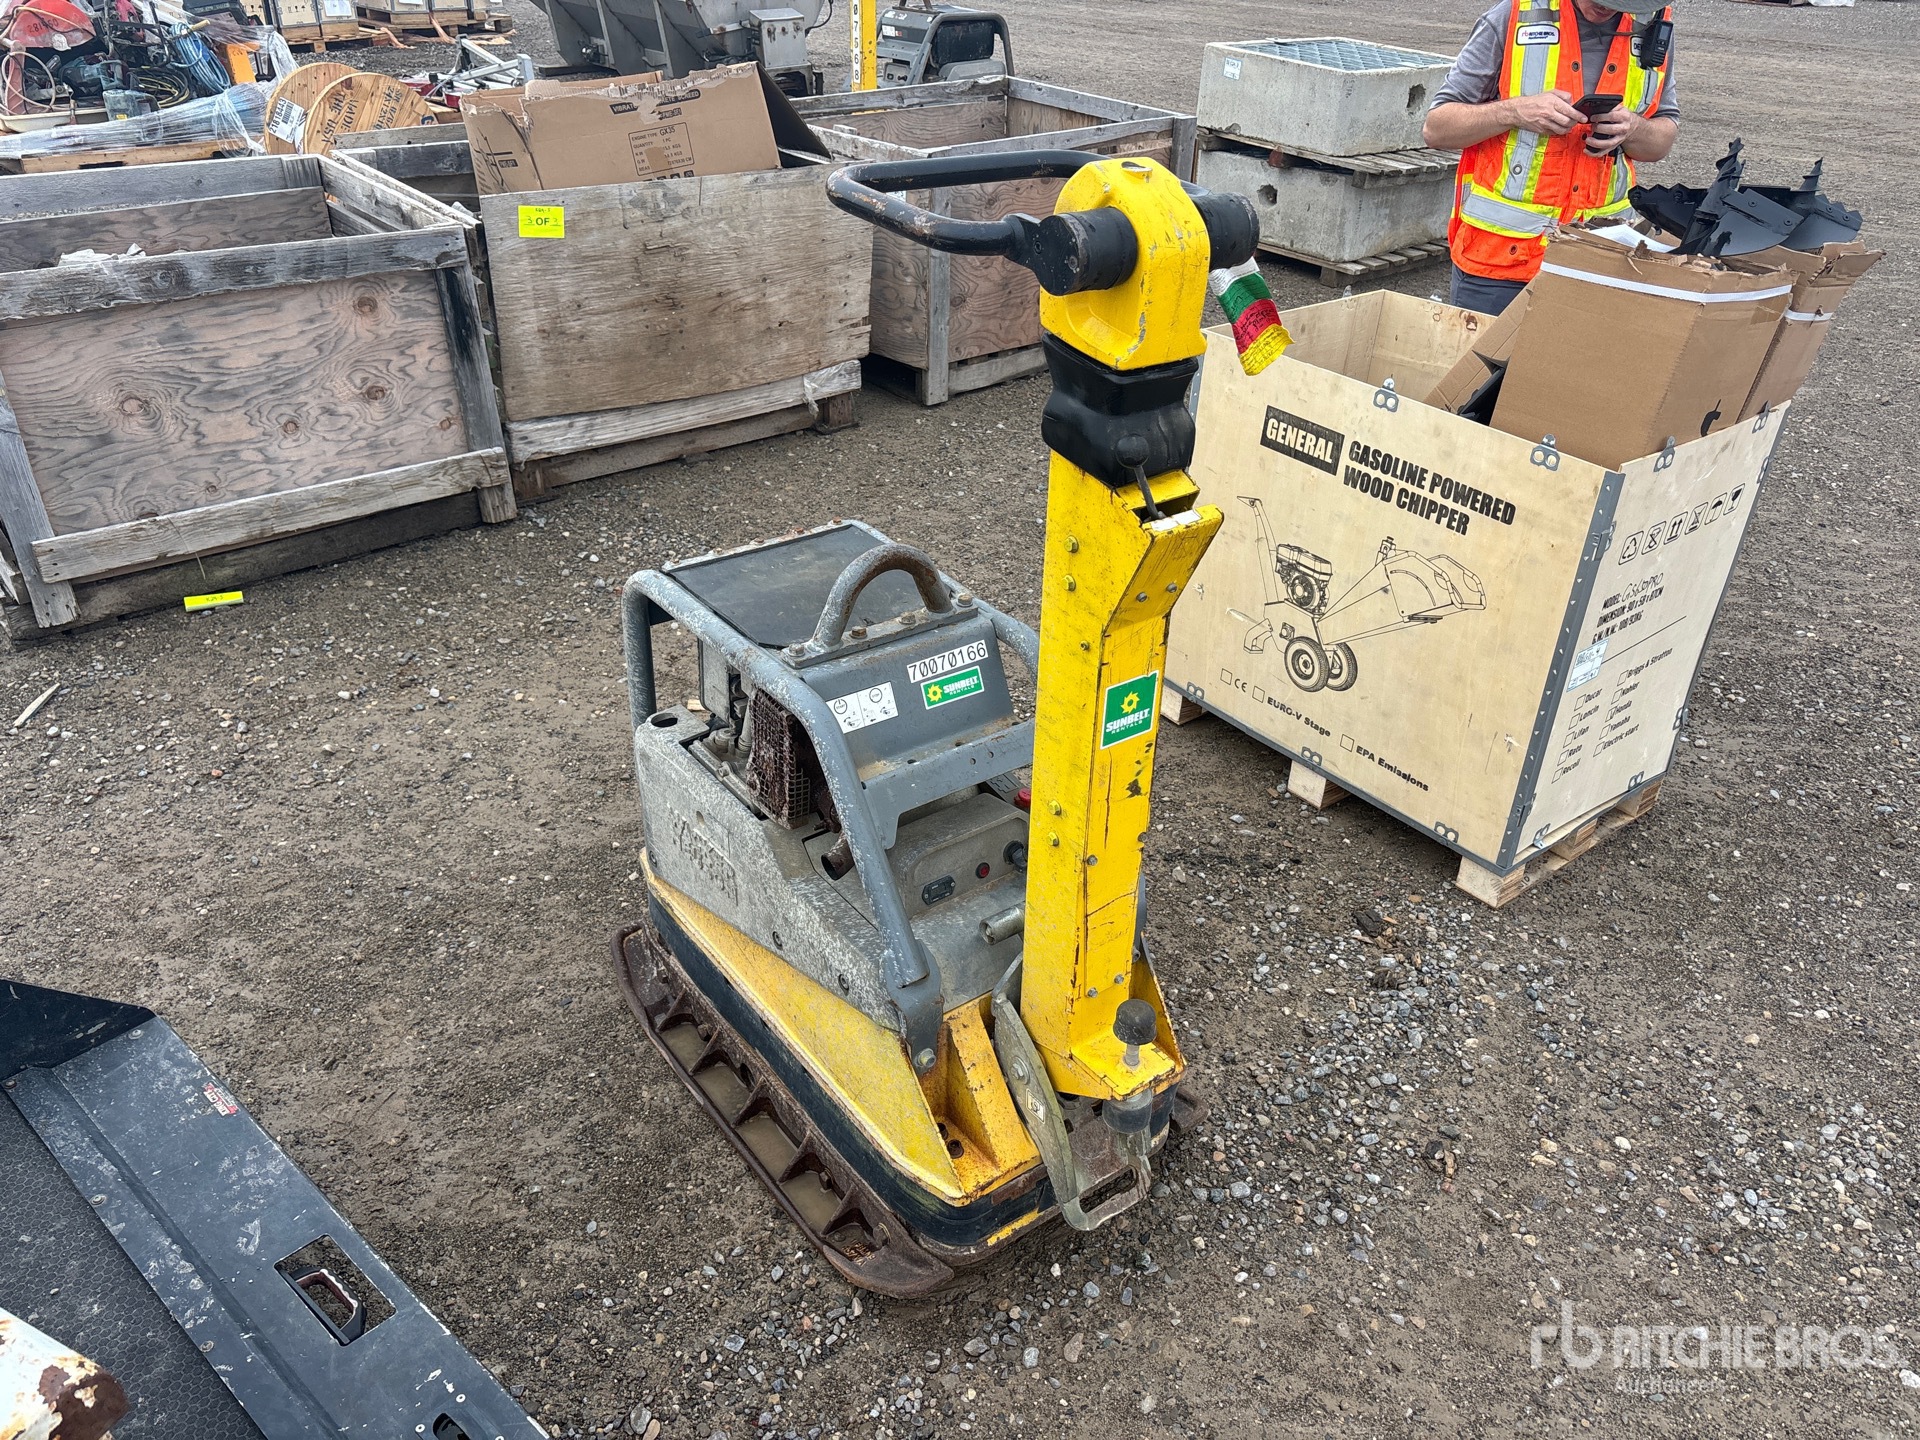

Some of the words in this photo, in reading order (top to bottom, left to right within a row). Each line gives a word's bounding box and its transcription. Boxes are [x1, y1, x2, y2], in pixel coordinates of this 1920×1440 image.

[535, 216, 550, 226] OF
[1266, 418, 1335, 464] GENERAL
[1343, 465, 1395, 504] WOOD
[1396, 487, 1470, 536] CHIPPER
[1348, 440, 1428, 490] GASOLINE
[1429, 471, 1517, 526] POWERED
[909, 642, 986, 681] 70070166
[943, 675, 979, 693] SUNBELT
[1234, 678, 1248, 693] CE
[1105, 708, 1151, 733] SUNBELT
[1111, 719, 1144, 735] RENTALS
[1267, 696, 1303, 721] EURO-V
[1303, 716, 1331, 737] Stage
[1356, 745, 1376, 763] EPA
[1377, 757, 1430, 792] Emissions
